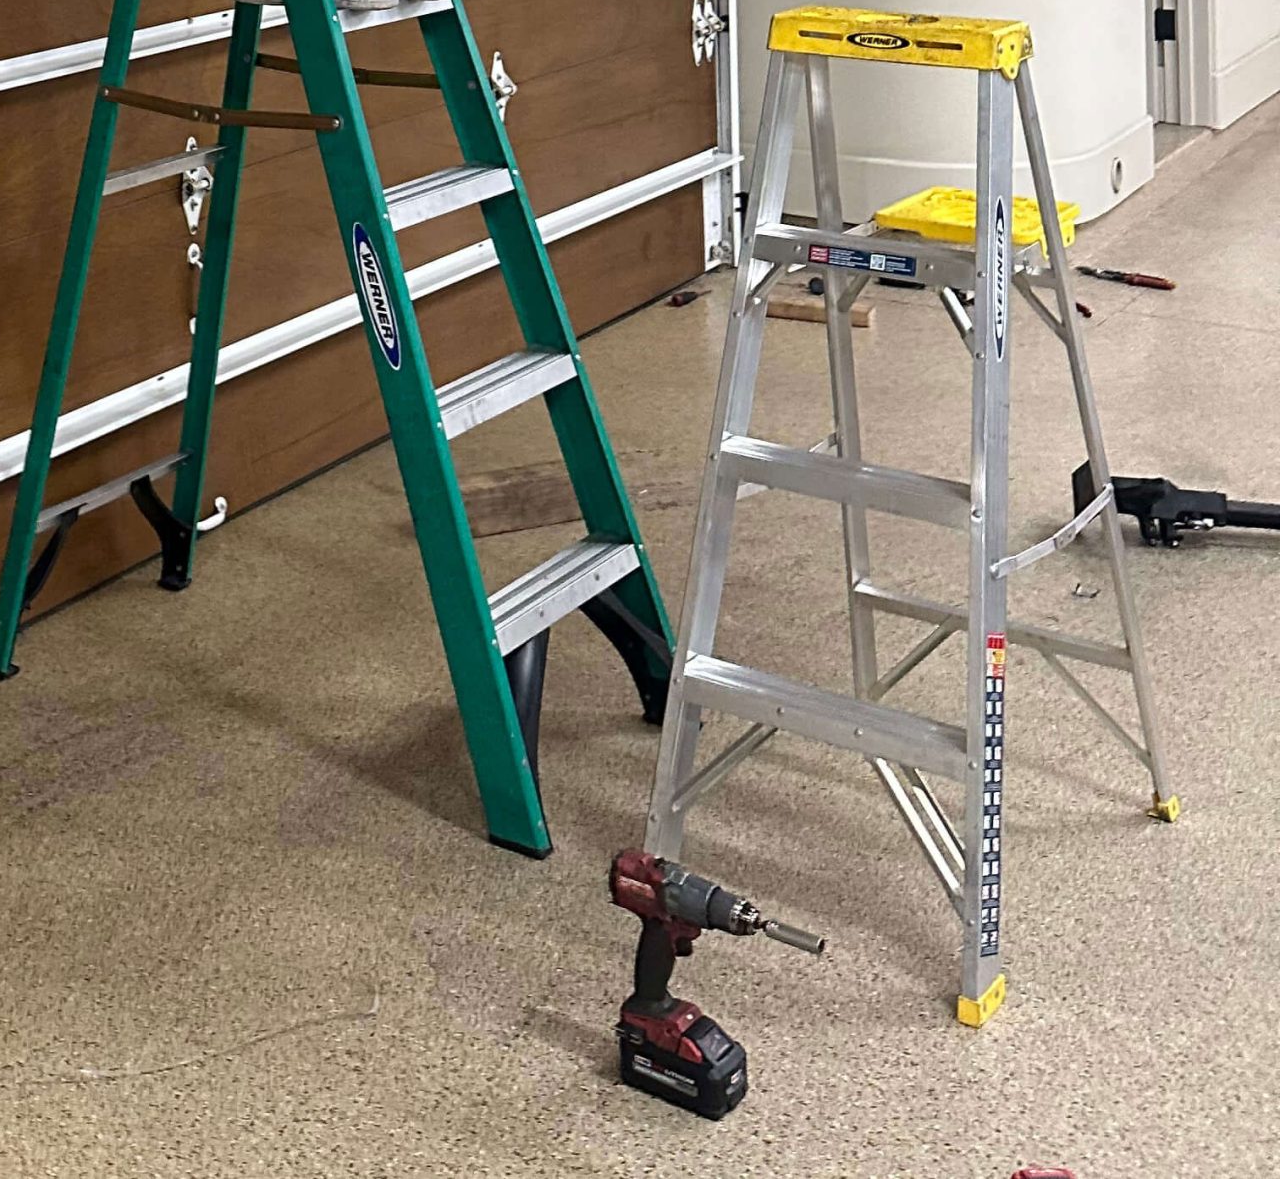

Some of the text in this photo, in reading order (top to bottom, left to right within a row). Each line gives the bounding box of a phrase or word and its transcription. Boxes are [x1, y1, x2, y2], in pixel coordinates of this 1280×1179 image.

[859, 36, 898, 46] WERNER
[361, 252, 394, 340] WERNER
[996, 229, 1004, 325] WERNER
